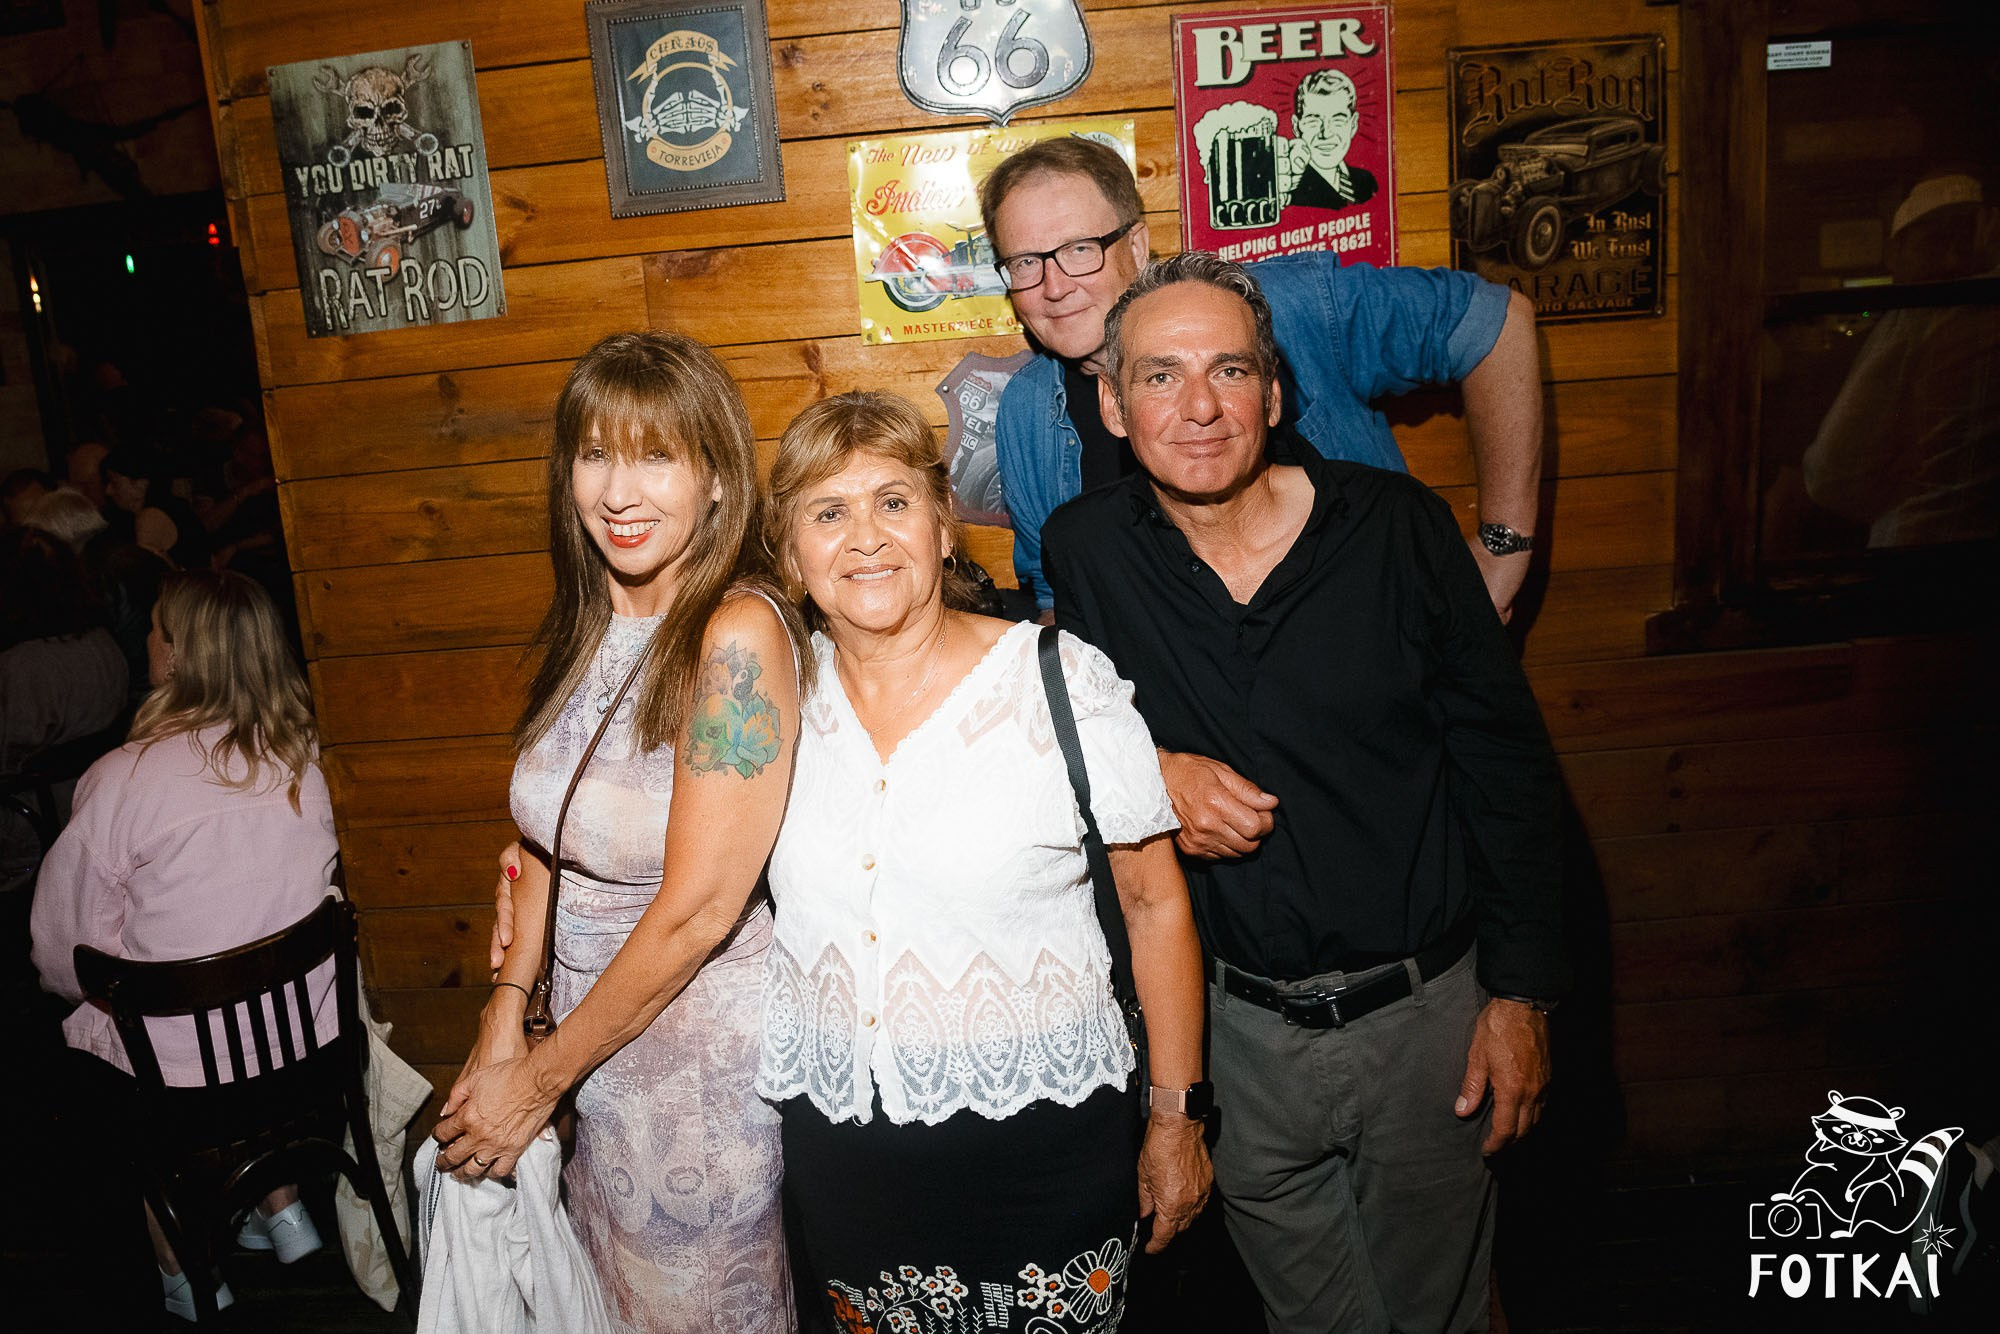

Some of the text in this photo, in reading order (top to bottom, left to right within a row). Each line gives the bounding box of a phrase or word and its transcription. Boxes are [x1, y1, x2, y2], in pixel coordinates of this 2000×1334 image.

[937, 8, 1050, 96] 66
[1192, 18, 1375, 87] BEER
[1552, 53, 1654, 121] Rod
[659, 144, 724, 166] TORREVIEJA
[866, 148, 895, 164] The
[901, 144, 956, 167] New
[295, 144, 474, 198] YOU DIRTY RAT
[1584, 211, 1651, 233] In Rust
[1218, 235, 1277, 262] HELPING
[1280, 226, 1315, 248] UGLY
[1318, 212, 1371, 239] PEOPLE
[1331, 230, 1372, 254] 1862!
[1607, 238, 1651, 257] Trust
[319, 256, 490, 330] RAT ROD
[1507, 266, 1652, 300] ARAGE
[885, 326, 892, 336] A
[903, 318, 993, 335] MASTERPIECE
[959, 390, 981, 410] 66
